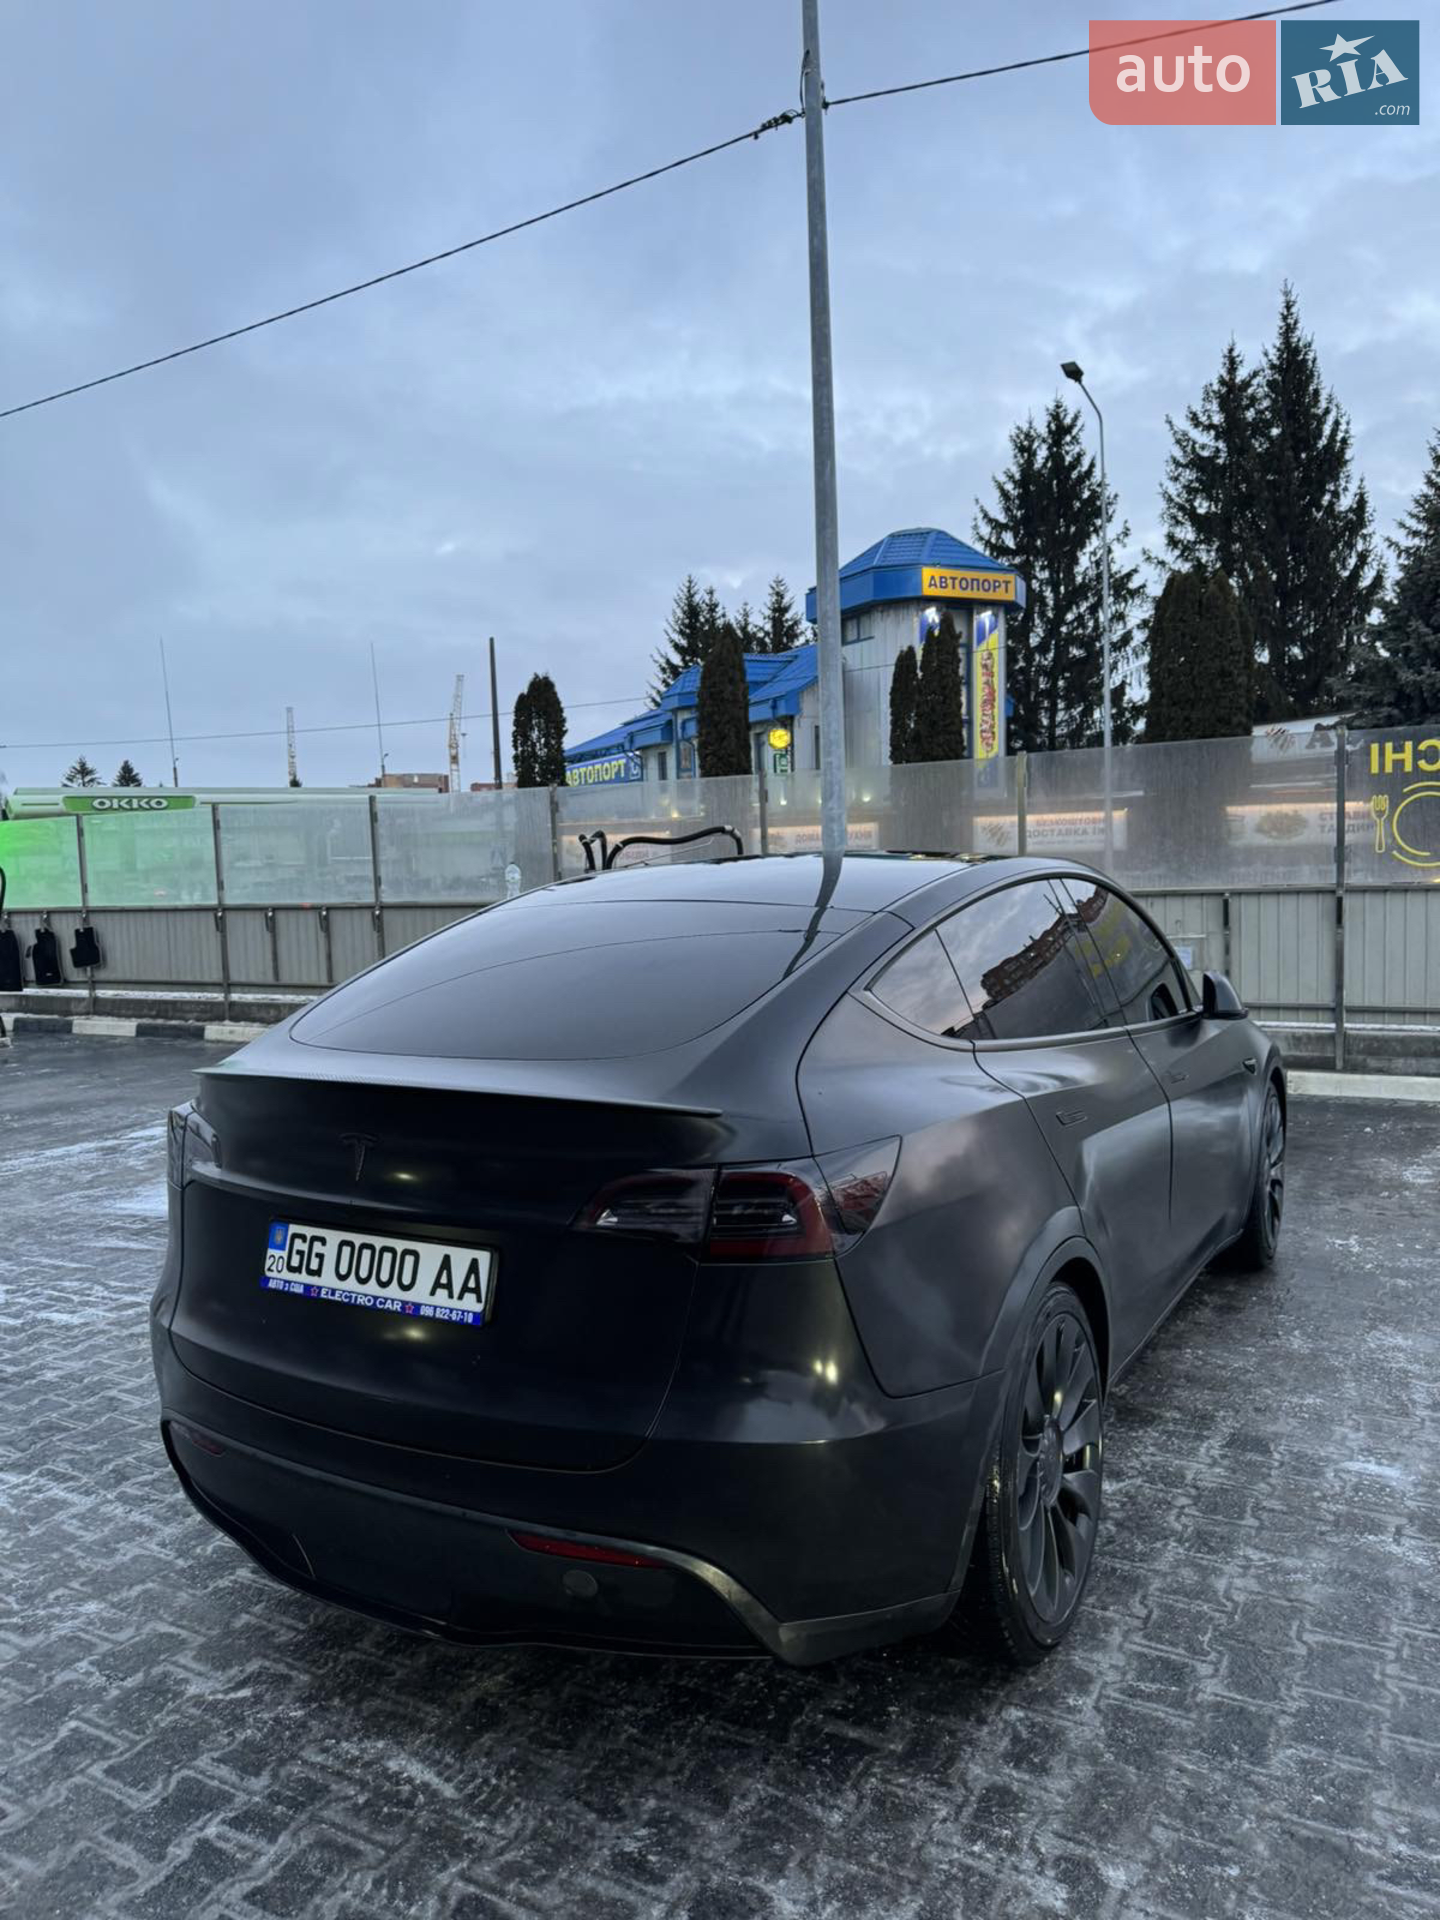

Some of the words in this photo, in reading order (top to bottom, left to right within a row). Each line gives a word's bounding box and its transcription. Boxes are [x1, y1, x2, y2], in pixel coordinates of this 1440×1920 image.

[928, 574, 1012, 594] АВТОПОРТ
[565, 759, 628, 787] АВТОПОРТ
[266, 1254, 285, 1274] 20
[286, 1232, 327, 1278] GG
[334, 1239, 421, 1292] 0000
[429, 1253, 483, 1304] AA
[320, 1287, 374, 1306] ELECTRO
[376, 1298, 402, 1312] CAR
